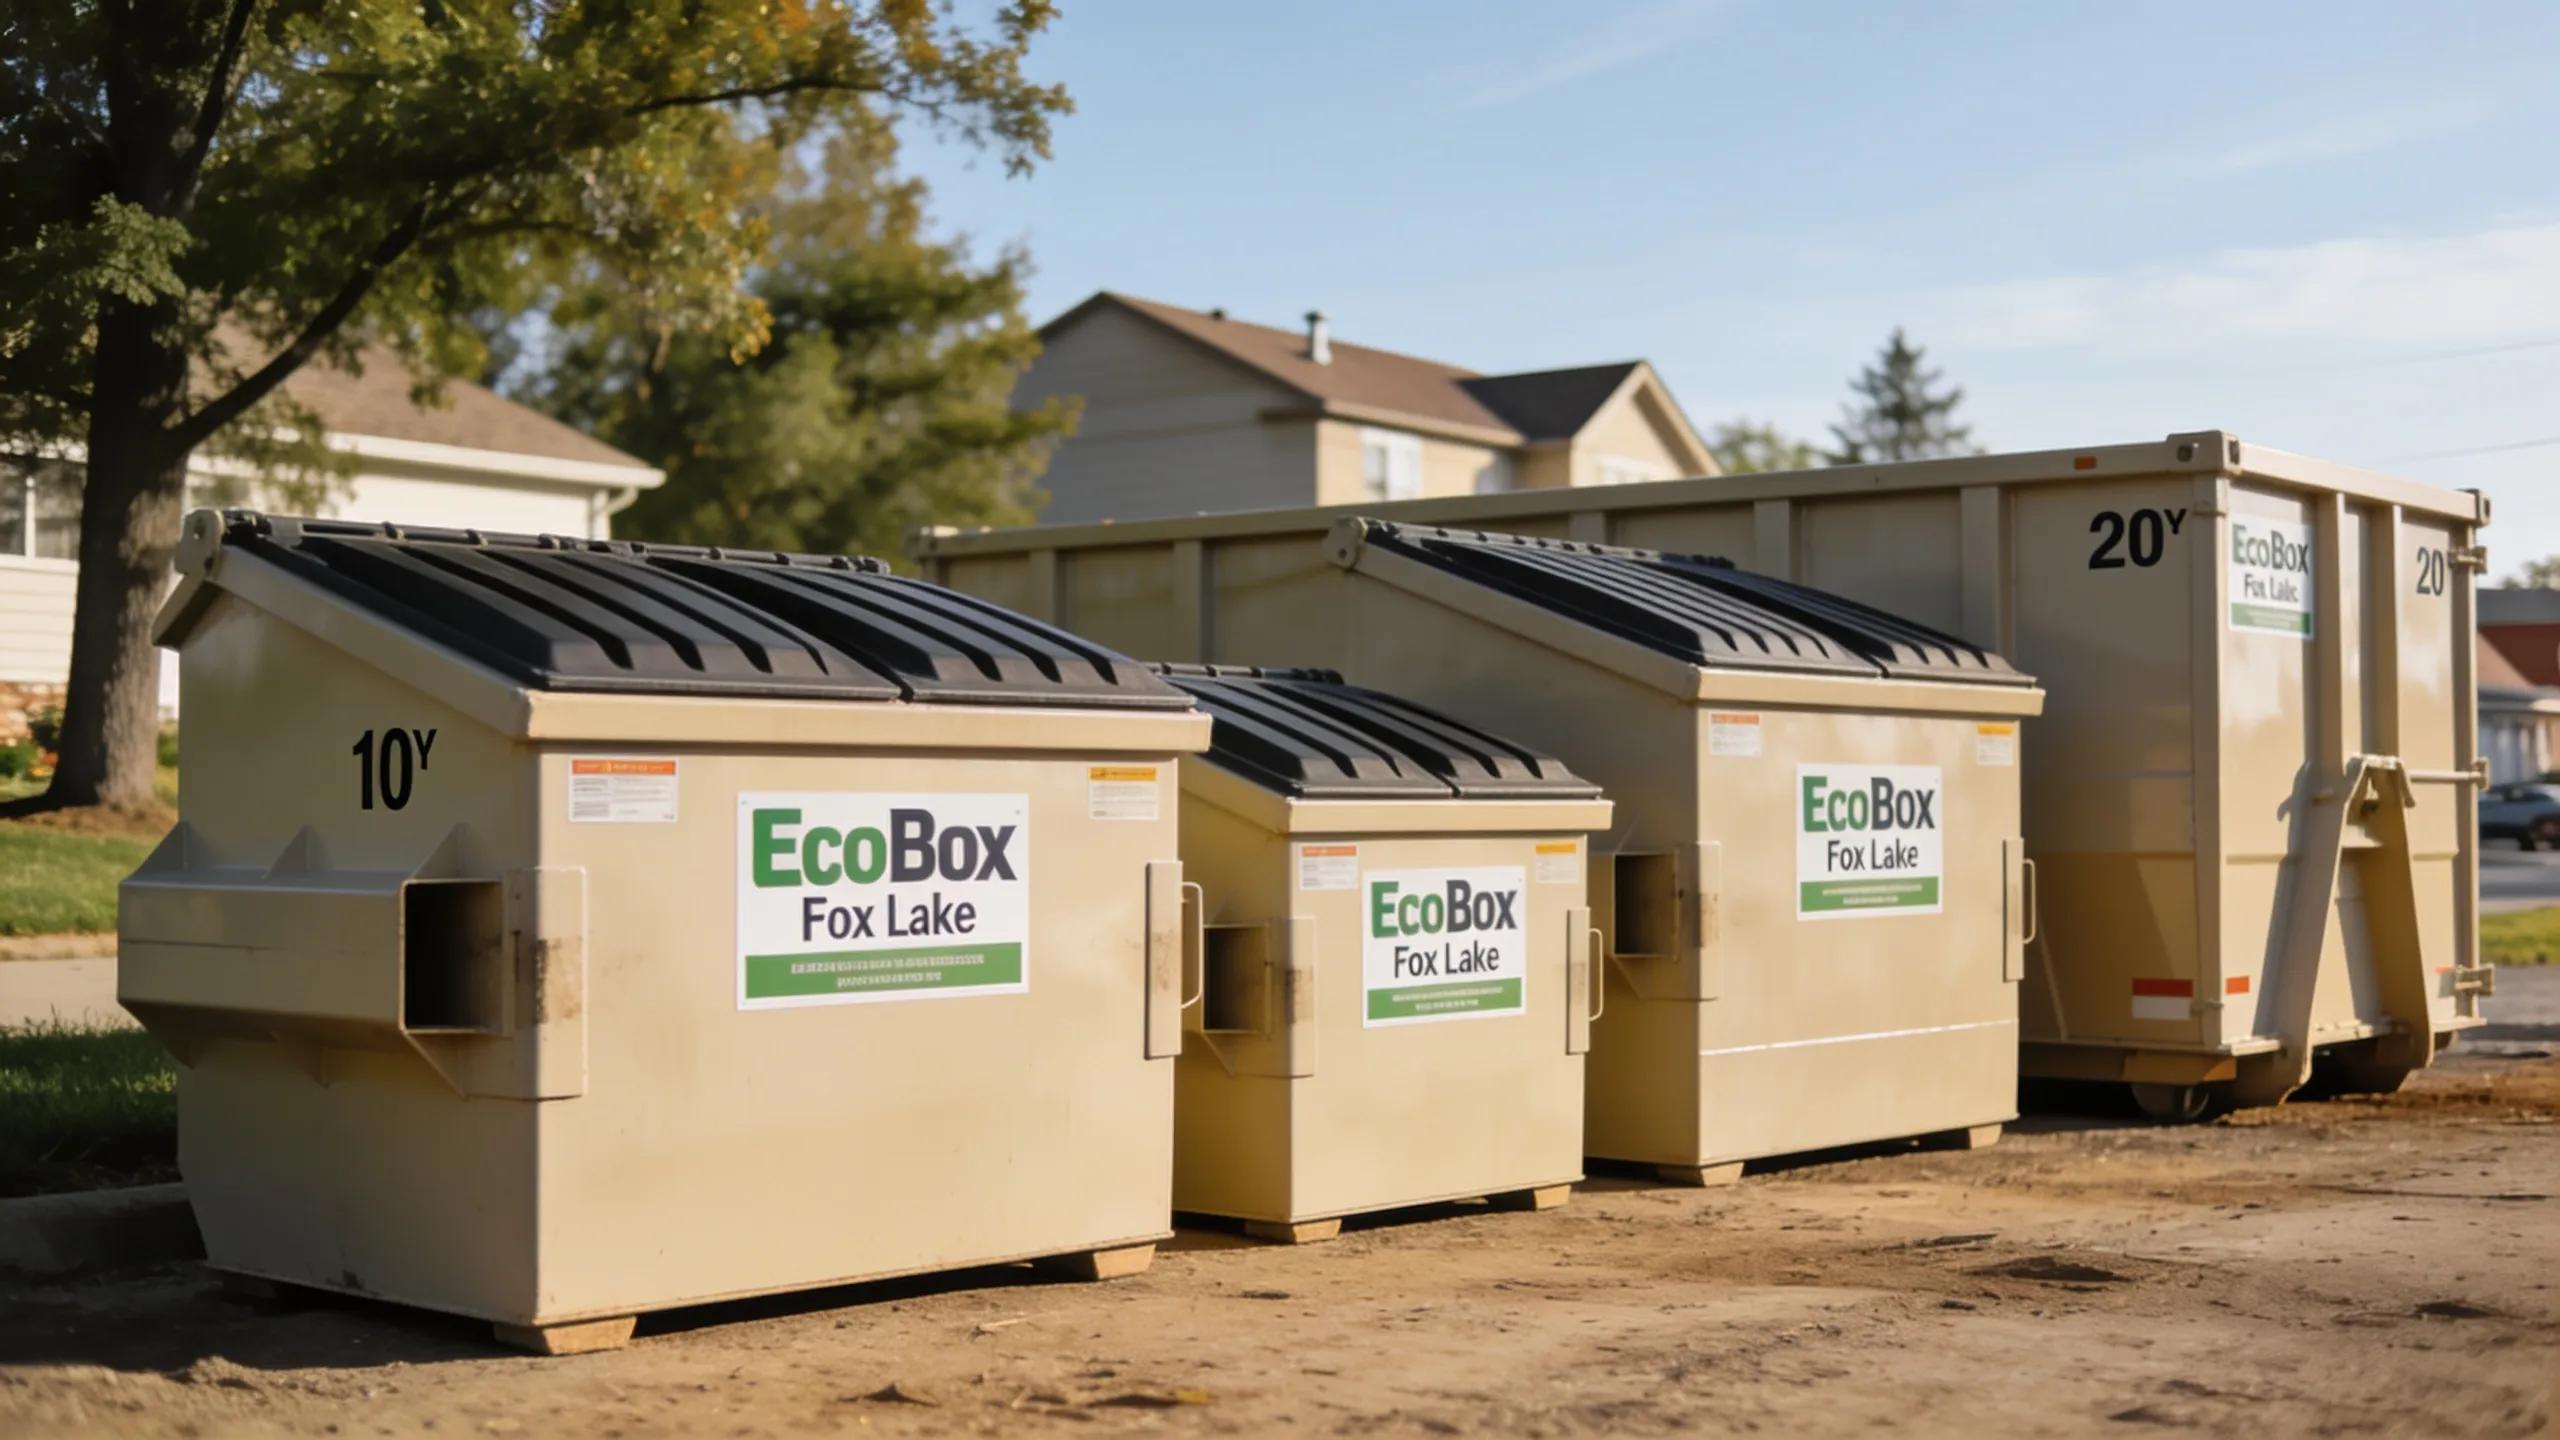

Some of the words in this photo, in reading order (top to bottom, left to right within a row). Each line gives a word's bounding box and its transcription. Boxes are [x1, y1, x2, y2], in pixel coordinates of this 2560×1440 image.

[2232, 523, 2309, 575] EcoBox
[2416, 545, 2445, 596] 20
[1802, 776, 1936, 832] EcoBox
[752, 808, 1018, 888] EcoBox
[1827, 840, 1866, 872] Fox
[1871, 838, 1919, 870] Lake
[802, 896, 875, 942] Fox
[887, 892, 977, 937] Lake
[1371, 879, 1518, 939] EcoBox
[1394, 945, 1439, 978] Fox
[1445, 939, 1500, 974] Lake
